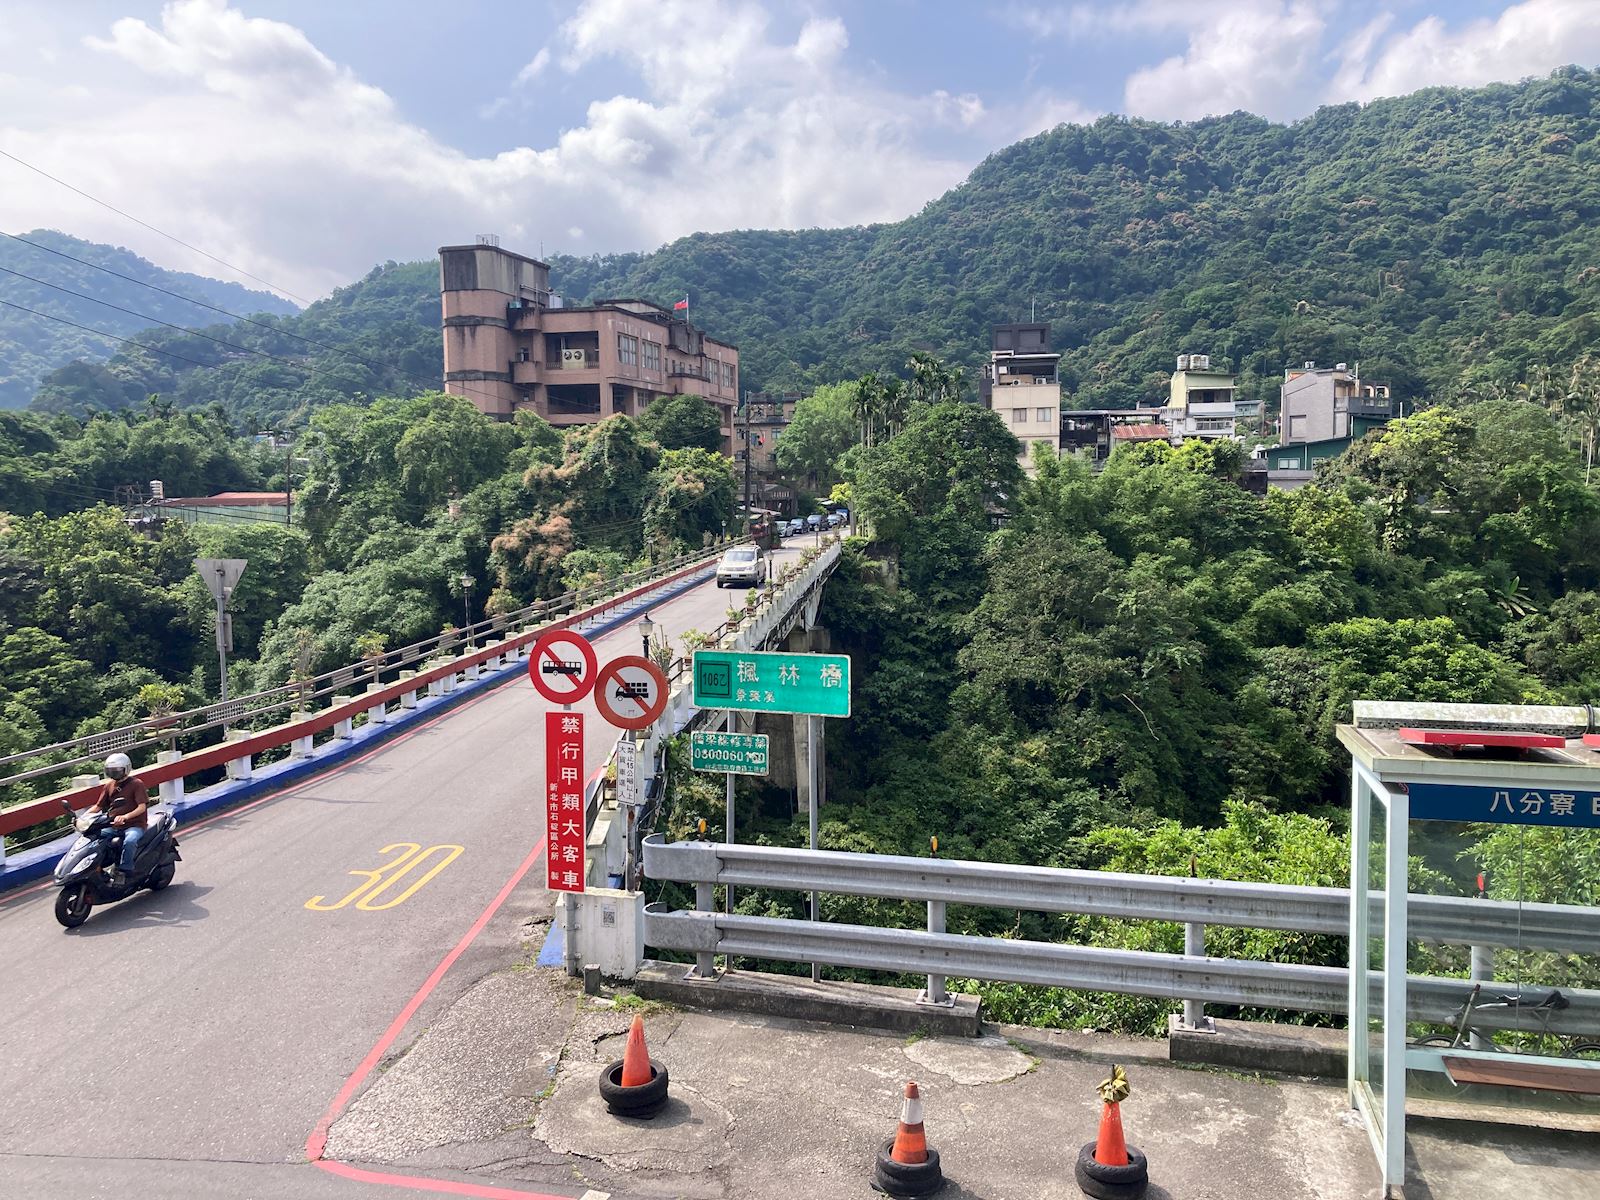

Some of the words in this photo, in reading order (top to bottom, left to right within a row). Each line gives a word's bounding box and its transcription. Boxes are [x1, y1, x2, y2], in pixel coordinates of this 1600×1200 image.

[737, 660, 843, 688] 楓林橋
[561, 716, 581, 888] 禁行甲類大客車
[1489, 791, 1576, 816] 八分寮
[303, 842, 465, 911] 30
